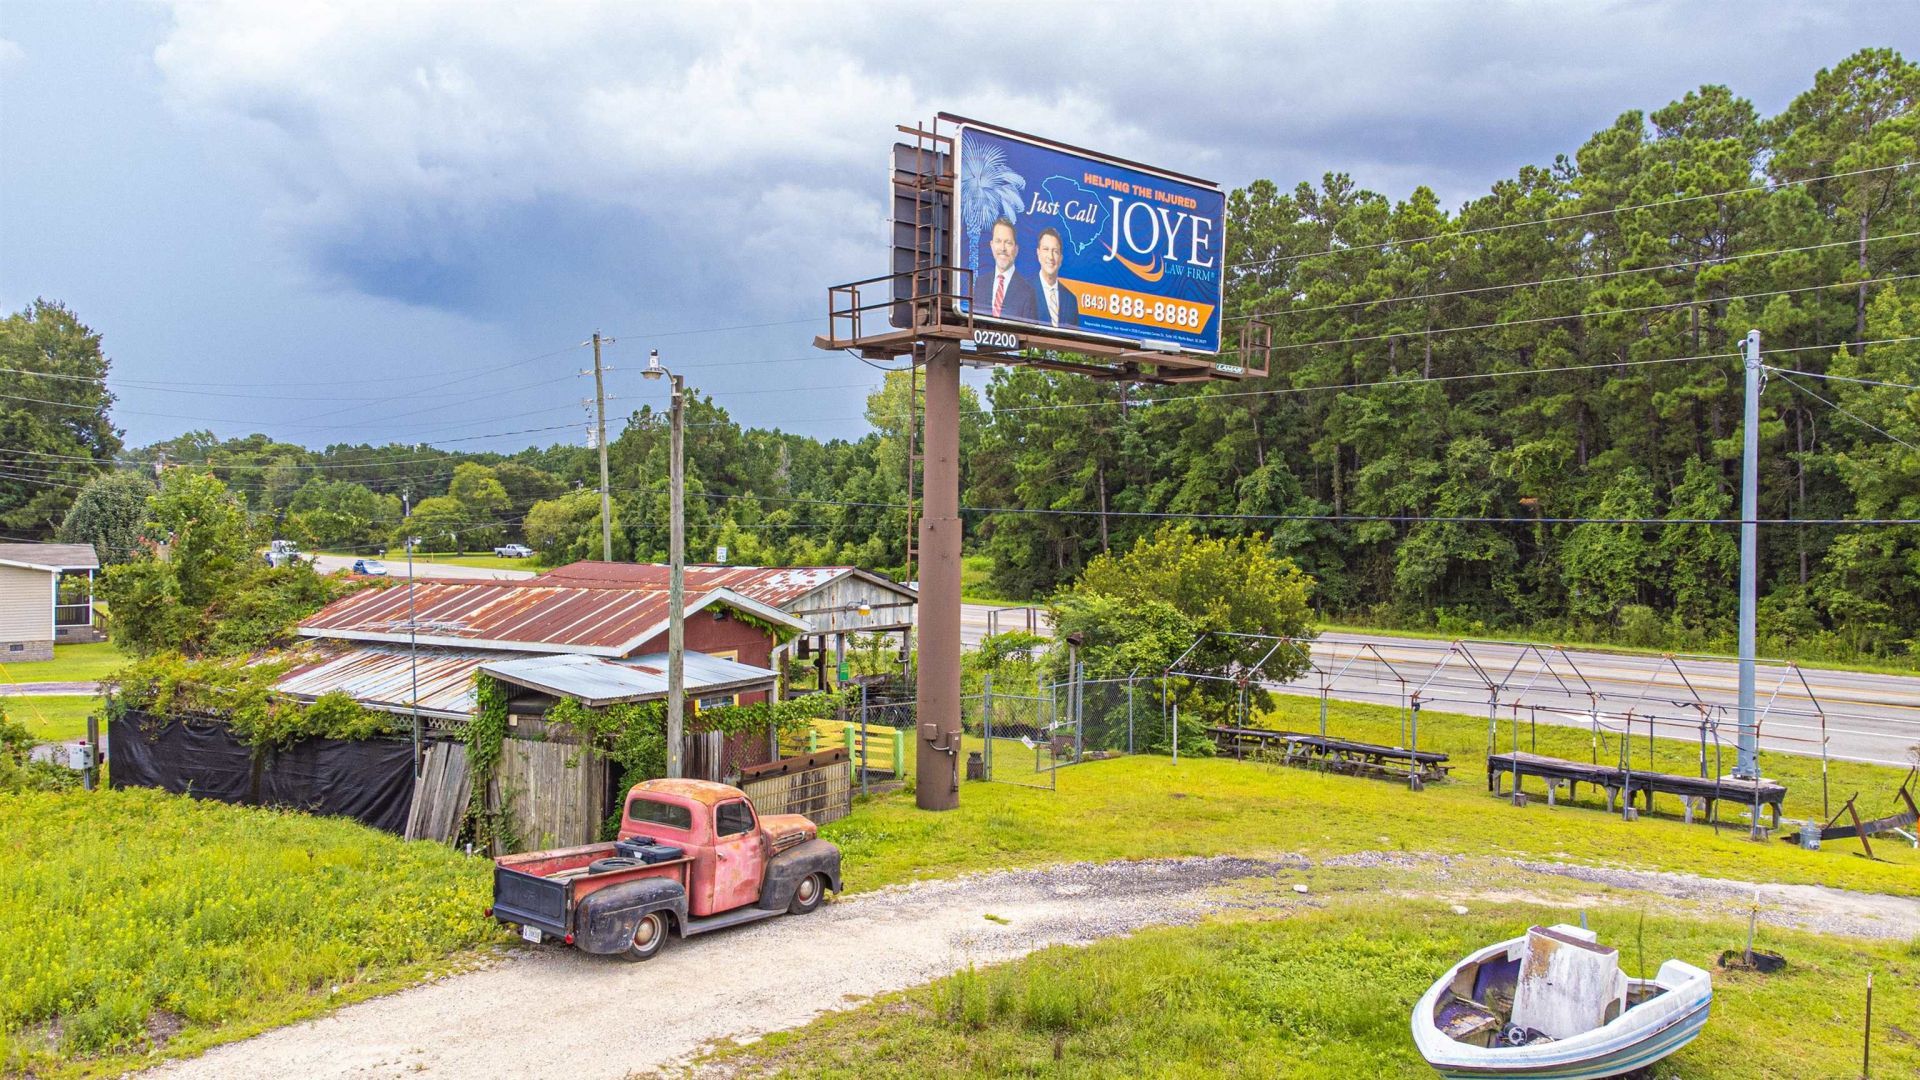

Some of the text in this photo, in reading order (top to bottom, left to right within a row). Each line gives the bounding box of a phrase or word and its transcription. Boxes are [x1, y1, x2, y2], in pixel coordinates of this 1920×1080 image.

[1084, 172, 1197, 210] HELPING THE INJURED
[1026, 192, 1098, 224] Just Call
[1102, 195, 1214, 268] JOYE
[1164, 262, 1185, 276] LAW
[1081, 293, 1199, 328] (843) 888-8888
[974, 330, 1016, 348] 027200
